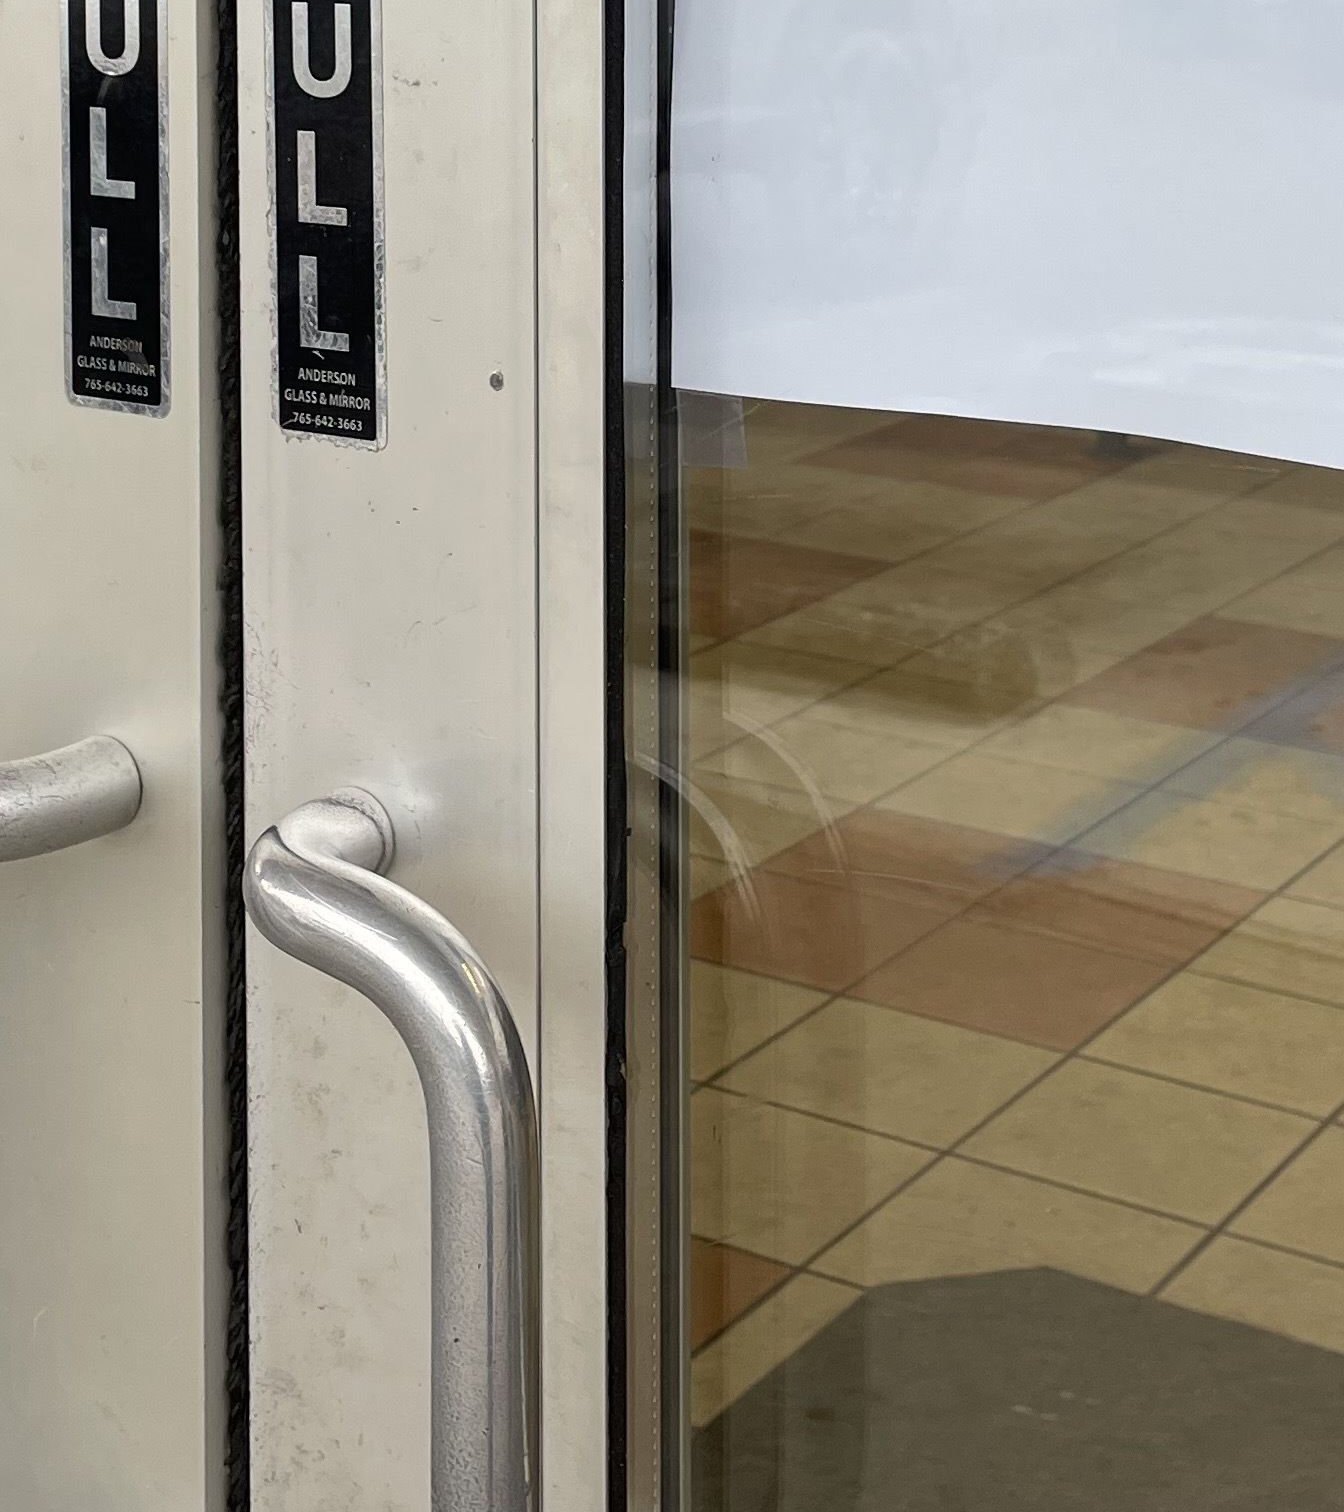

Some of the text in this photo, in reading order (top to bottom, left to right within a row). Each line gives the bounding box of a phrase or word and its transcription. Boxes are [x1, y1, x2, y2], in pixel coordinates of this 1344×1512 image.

[89, 335, 143, 354] ANDERSON
[77, 355, 156, 377] GLASS & MIRROR
[297, 367, 356, 386] ANDERSON
[84, 377, 149, 397] 765-642-3663
[284, 387, 371, 411] GLASS & MIRROR
[292, 411, 363, 432] 765-642-3663
